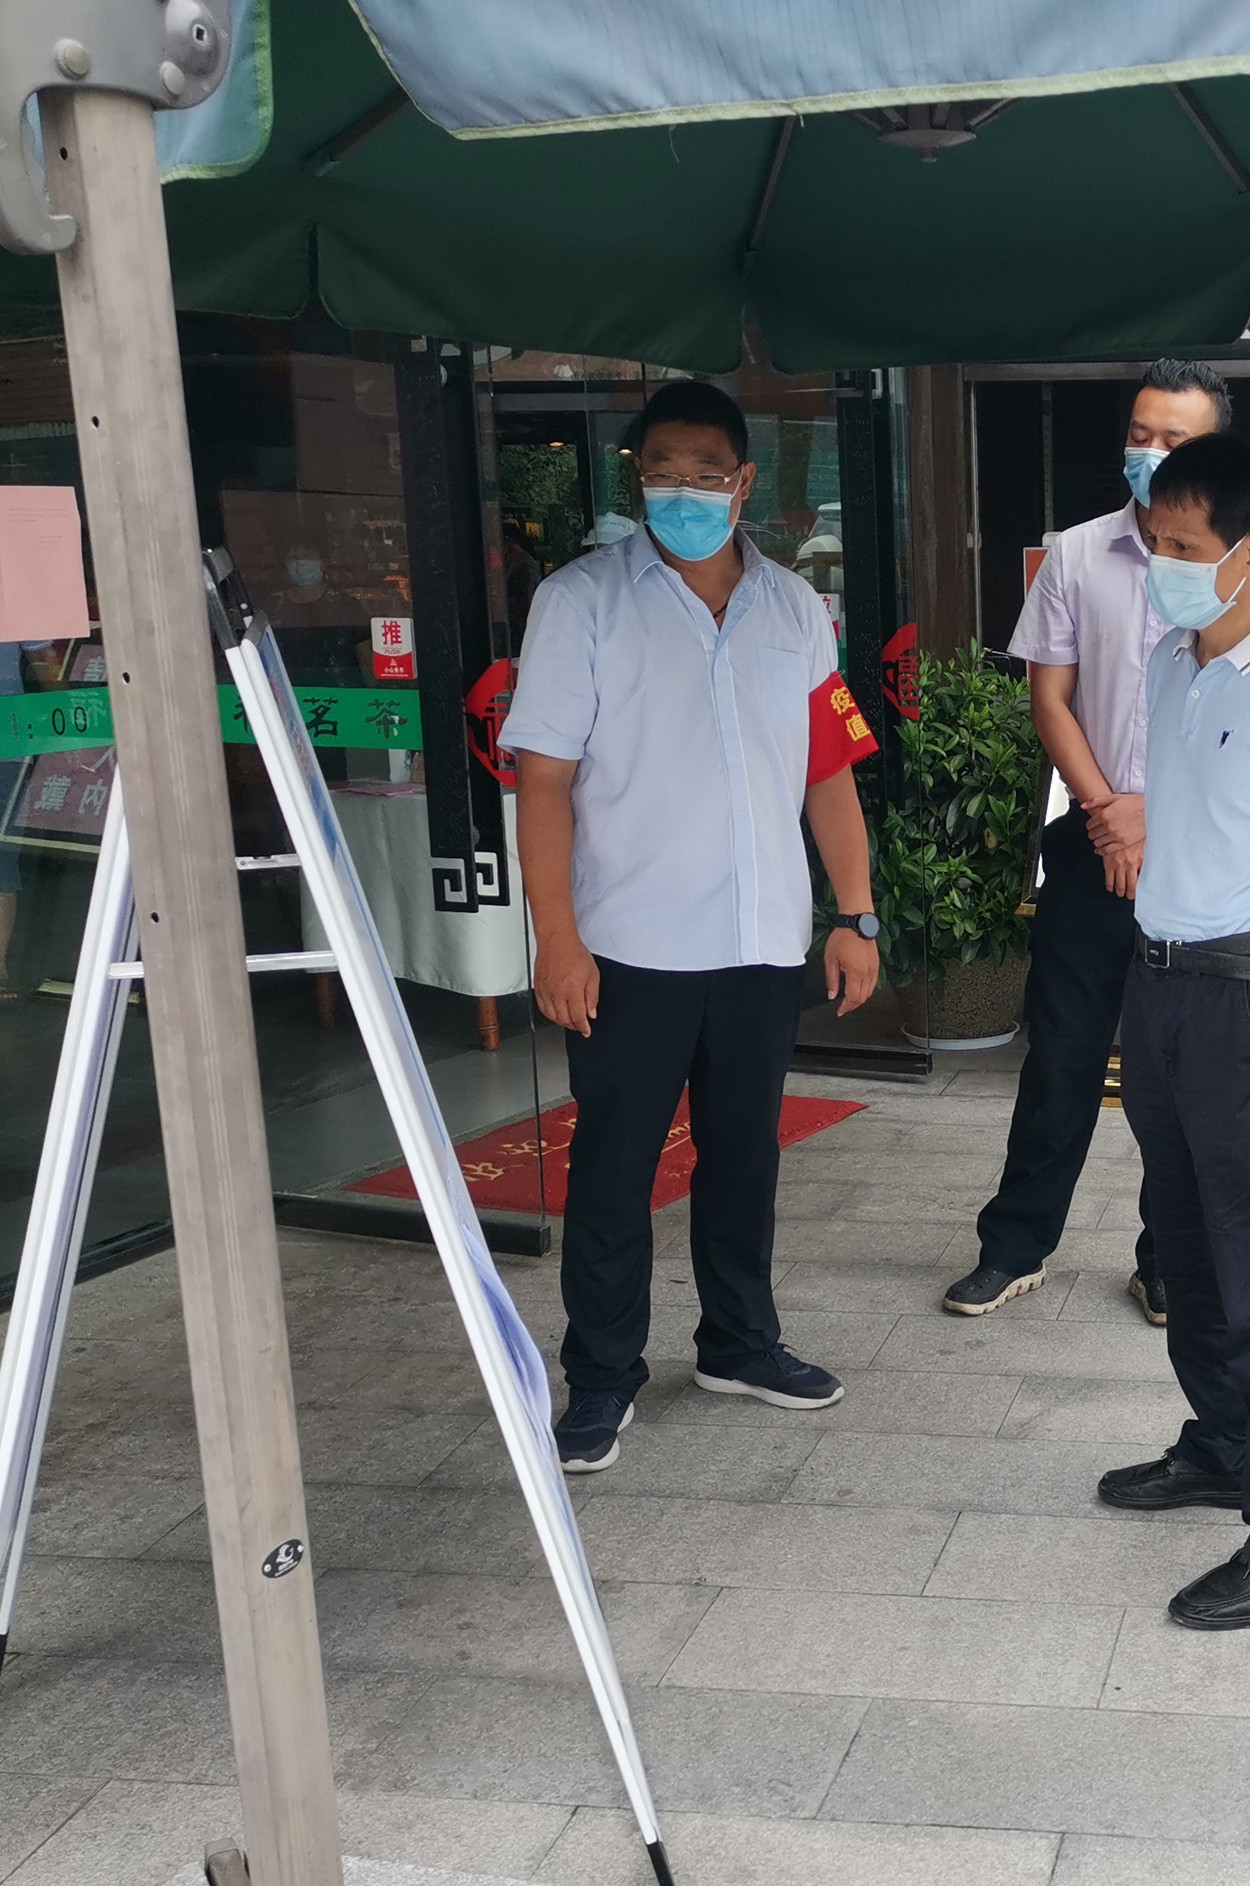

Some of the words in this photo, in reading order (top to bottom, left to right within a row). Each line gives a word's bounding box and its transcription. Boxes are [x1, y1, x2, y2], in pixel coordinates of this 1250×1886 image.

[381, 620, 403, 646] 推
[830, 686, 856, 716] 疫
[845, 713, 872, 742] 值
